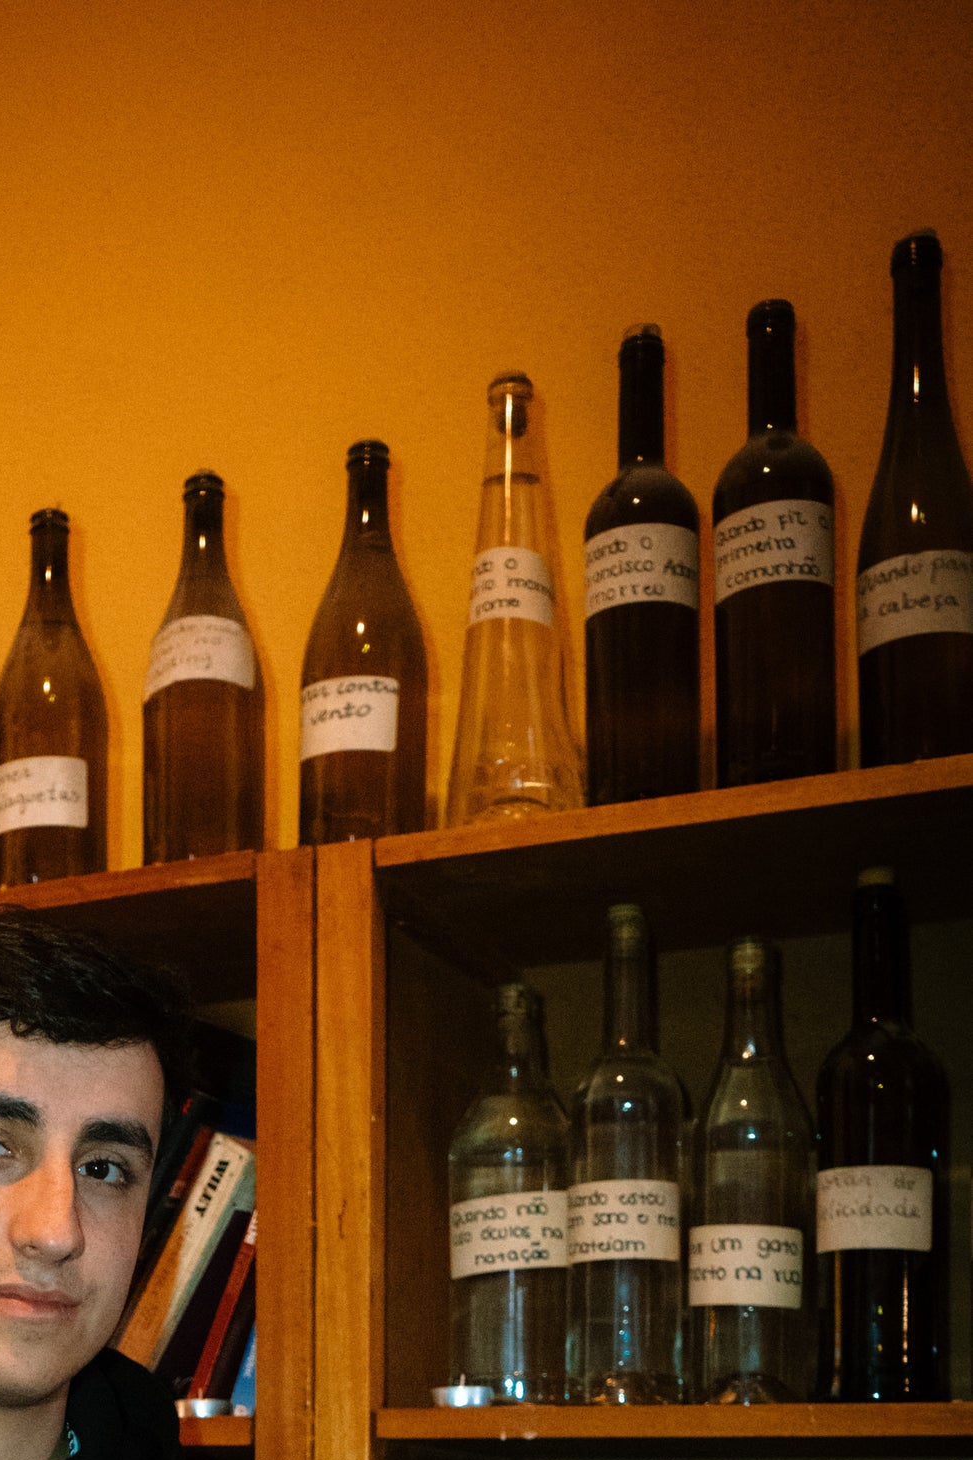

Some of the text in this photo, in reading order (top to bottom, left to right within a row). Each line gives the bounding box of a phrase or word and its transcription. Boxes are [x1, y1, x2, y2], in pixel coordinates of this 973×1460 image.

[725, 555, 823, 589] comunhão
[879, 591, 960, 616] cabeça
[311, 702, 370, 726] vento
[194, 1160, 230, 1218] WILEY
[515, 1195, 548, 1217] não
[541, 1225, 564, 1241] na
[473, 1239, 549, 1266] natação
[710, 1236, 742, 1254] um
[757, 1236, 799, 1259] gato
[734, 1264, 761, 1282] na
[773, 1267, 801, 1285] rua
